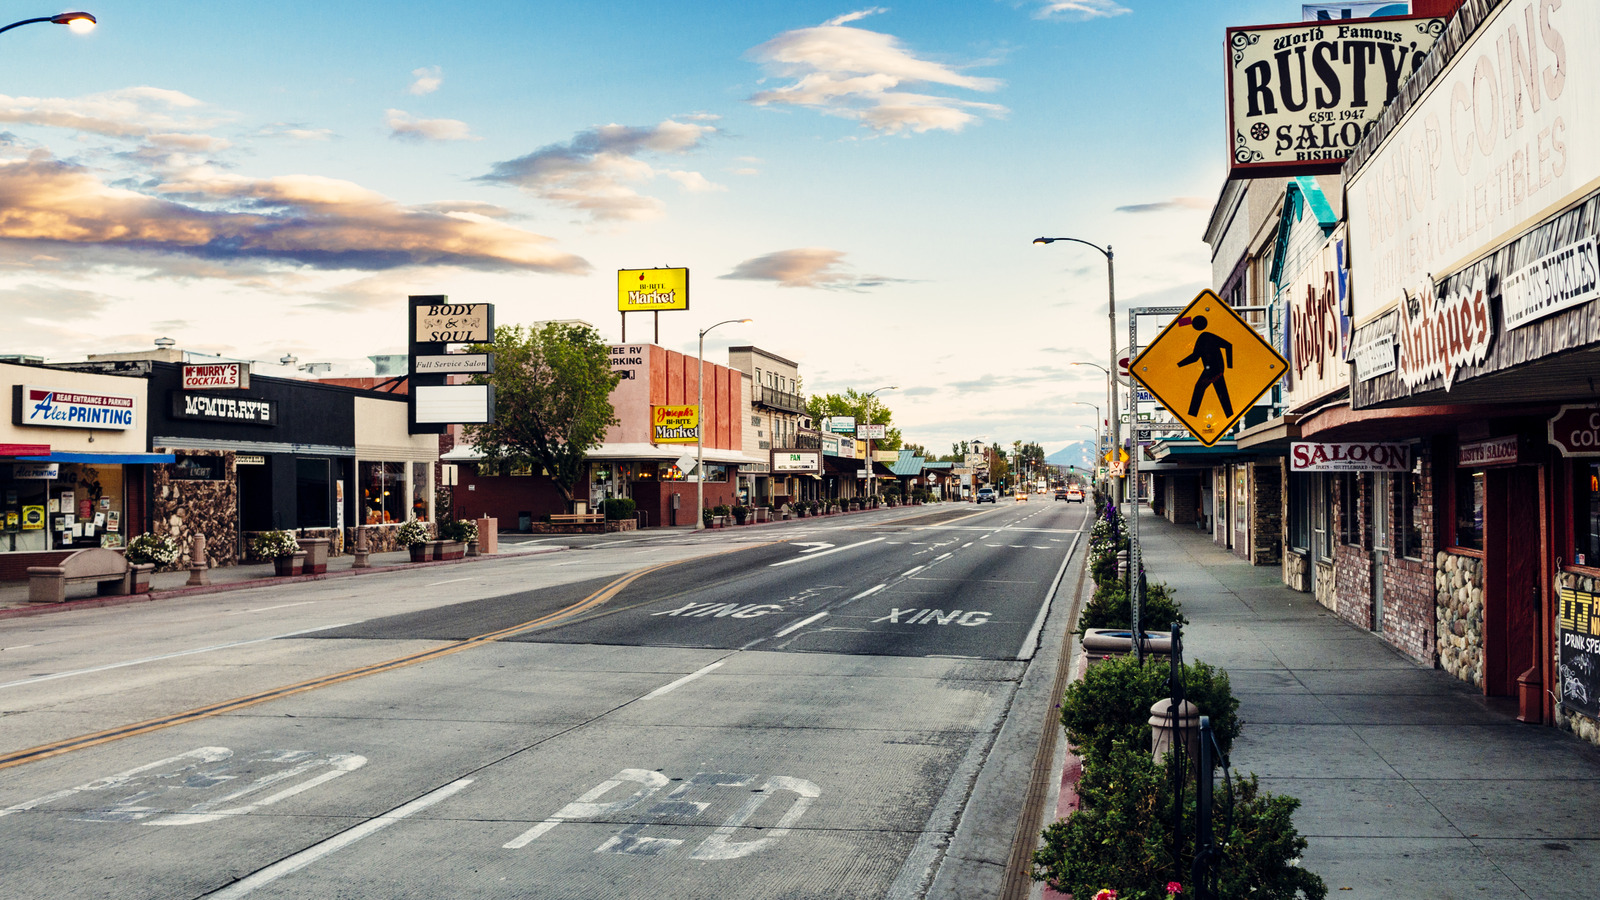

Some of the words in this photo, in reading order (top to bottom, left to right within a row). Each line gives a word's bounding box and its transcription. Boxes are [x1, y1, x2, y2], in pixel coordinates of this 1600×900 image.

[1273, 27, 1324, 51] World
[1337, 26, 1403, 43] Famous
[1309, 111, 1336, 123] EST.
[1339, 109, 1365, 121] 1947
[1365, 112, 1441, 251] BISHOP
[1449, 0, 1567, 176] COINS
[1439, 116, 1567, 252] COLLECTIBLES
[1541, 242, 1597, 306] BUCKLES
[628, 289, 676, 305] Market
[428, 304, 477, 316] BODY
[445, 318, 459, 329] &
[429, 331, 475, 342] SOUL
[1400, 288, 1488, 380] Antiques
[629, 346, 642, 354] RV
[464, 359, 486, 367] Salon
[186, 376, 236, 386] COCKTAILS
[56, 393, 72, 402] REAR
[72, 394, 102, 404] ENTRANCE
[107, 398, 131, 407] PARKING
[1137, 391, 1155, 400] PARK
[30, 392, 67, 421] Alex
[68, 406, 132, 425] PRINTING
[654, 424, 699, 439] Market
[1293, 444, 1409, 470] SALOON
[650, 602, 784, 619] XING
[871, 607, 993, 627] XING
[1561, 588, 1592, 634] DJ
[1564, 633, 1586, 652] DRINK
[502, 769, 822, 861] PED
